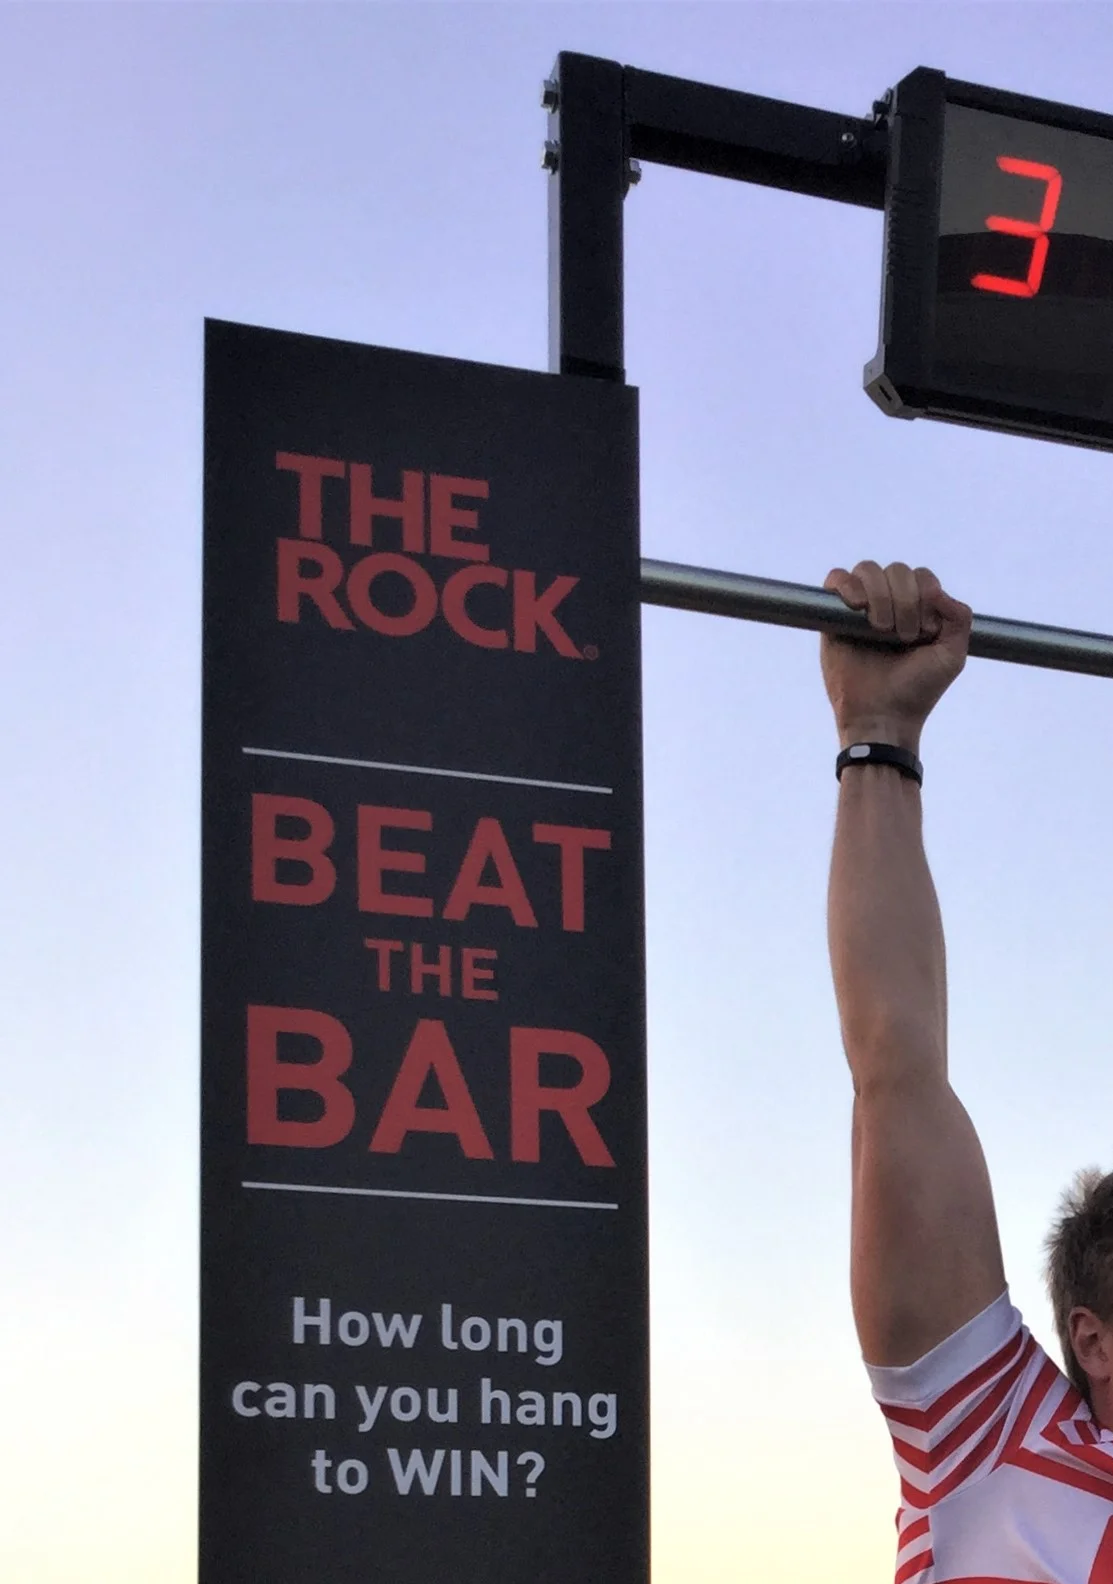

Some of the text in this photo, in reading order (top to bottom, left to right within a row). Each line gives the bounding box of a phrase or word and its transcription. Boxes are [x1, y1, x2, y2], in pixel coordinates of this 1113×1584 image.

[275, 451, 490, 562] THE
[275, 537, 584, 660] ROCK
[251, 793, 612, 933] BEAT
[364, 937, 499, 1001] THE
[246, 1004, 617, 1168] BAR
[292, 1296, 563, 1366] How long
[232, 1377, 618, 1439] can you hang
[311, 1448, 546, 1498] to WIN?
